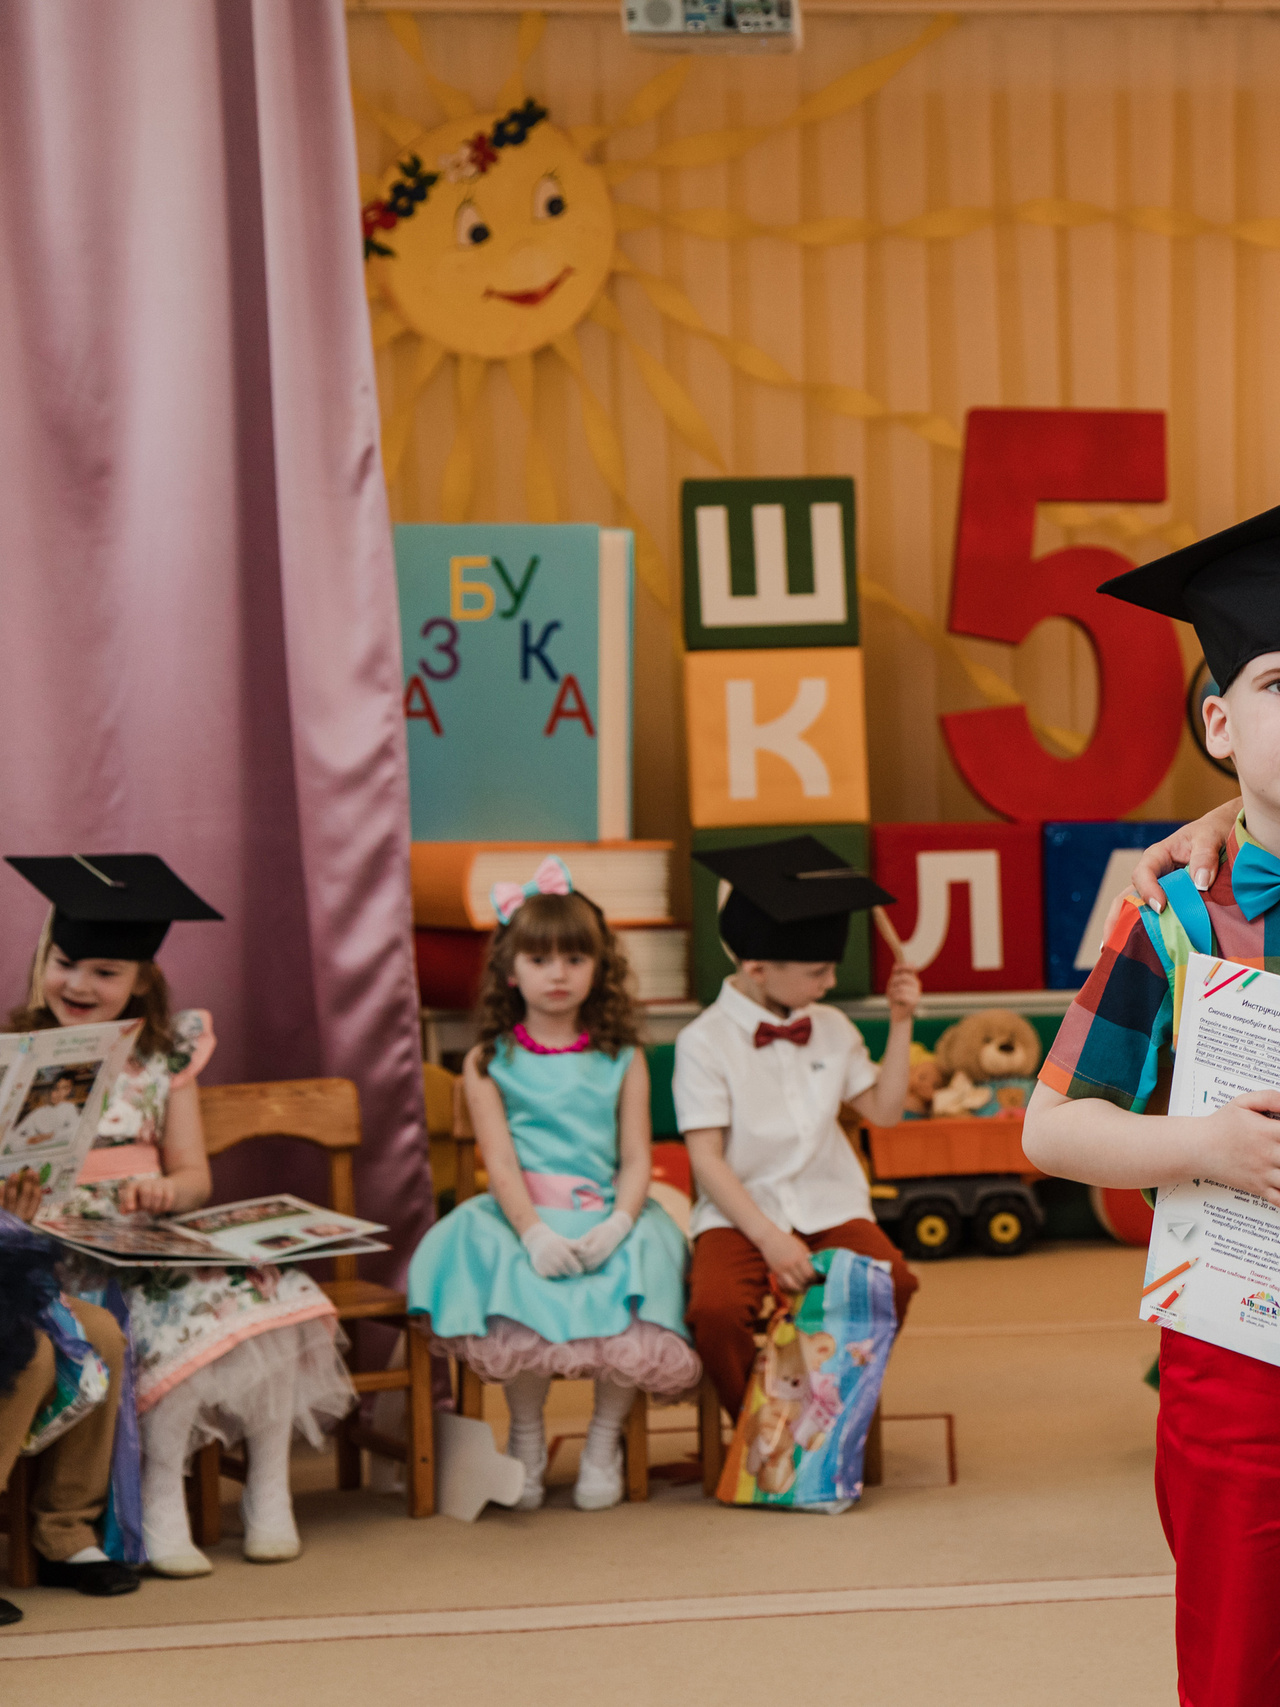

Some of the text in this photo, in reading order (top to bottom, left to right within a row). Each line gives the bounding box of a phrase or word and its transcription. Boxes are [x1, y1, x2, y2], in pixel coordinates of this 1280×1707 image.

[939, 407, 1185, 822] 5
[1208, 1007, 1232, 1019] Сначала
[1232, 1015, 1267, 1029] попробуйте
[1214, 1077, 1229, 1086] Если
[1203, 1090, 1208, 1104] 1
[1203, 1201, 1216, 1210] Если
[1252, 1199, 1268, 1210] 15-20
[1205, 1230, 1217, 1239] Если
[1240, 1297, 1271, 1313] Albums
